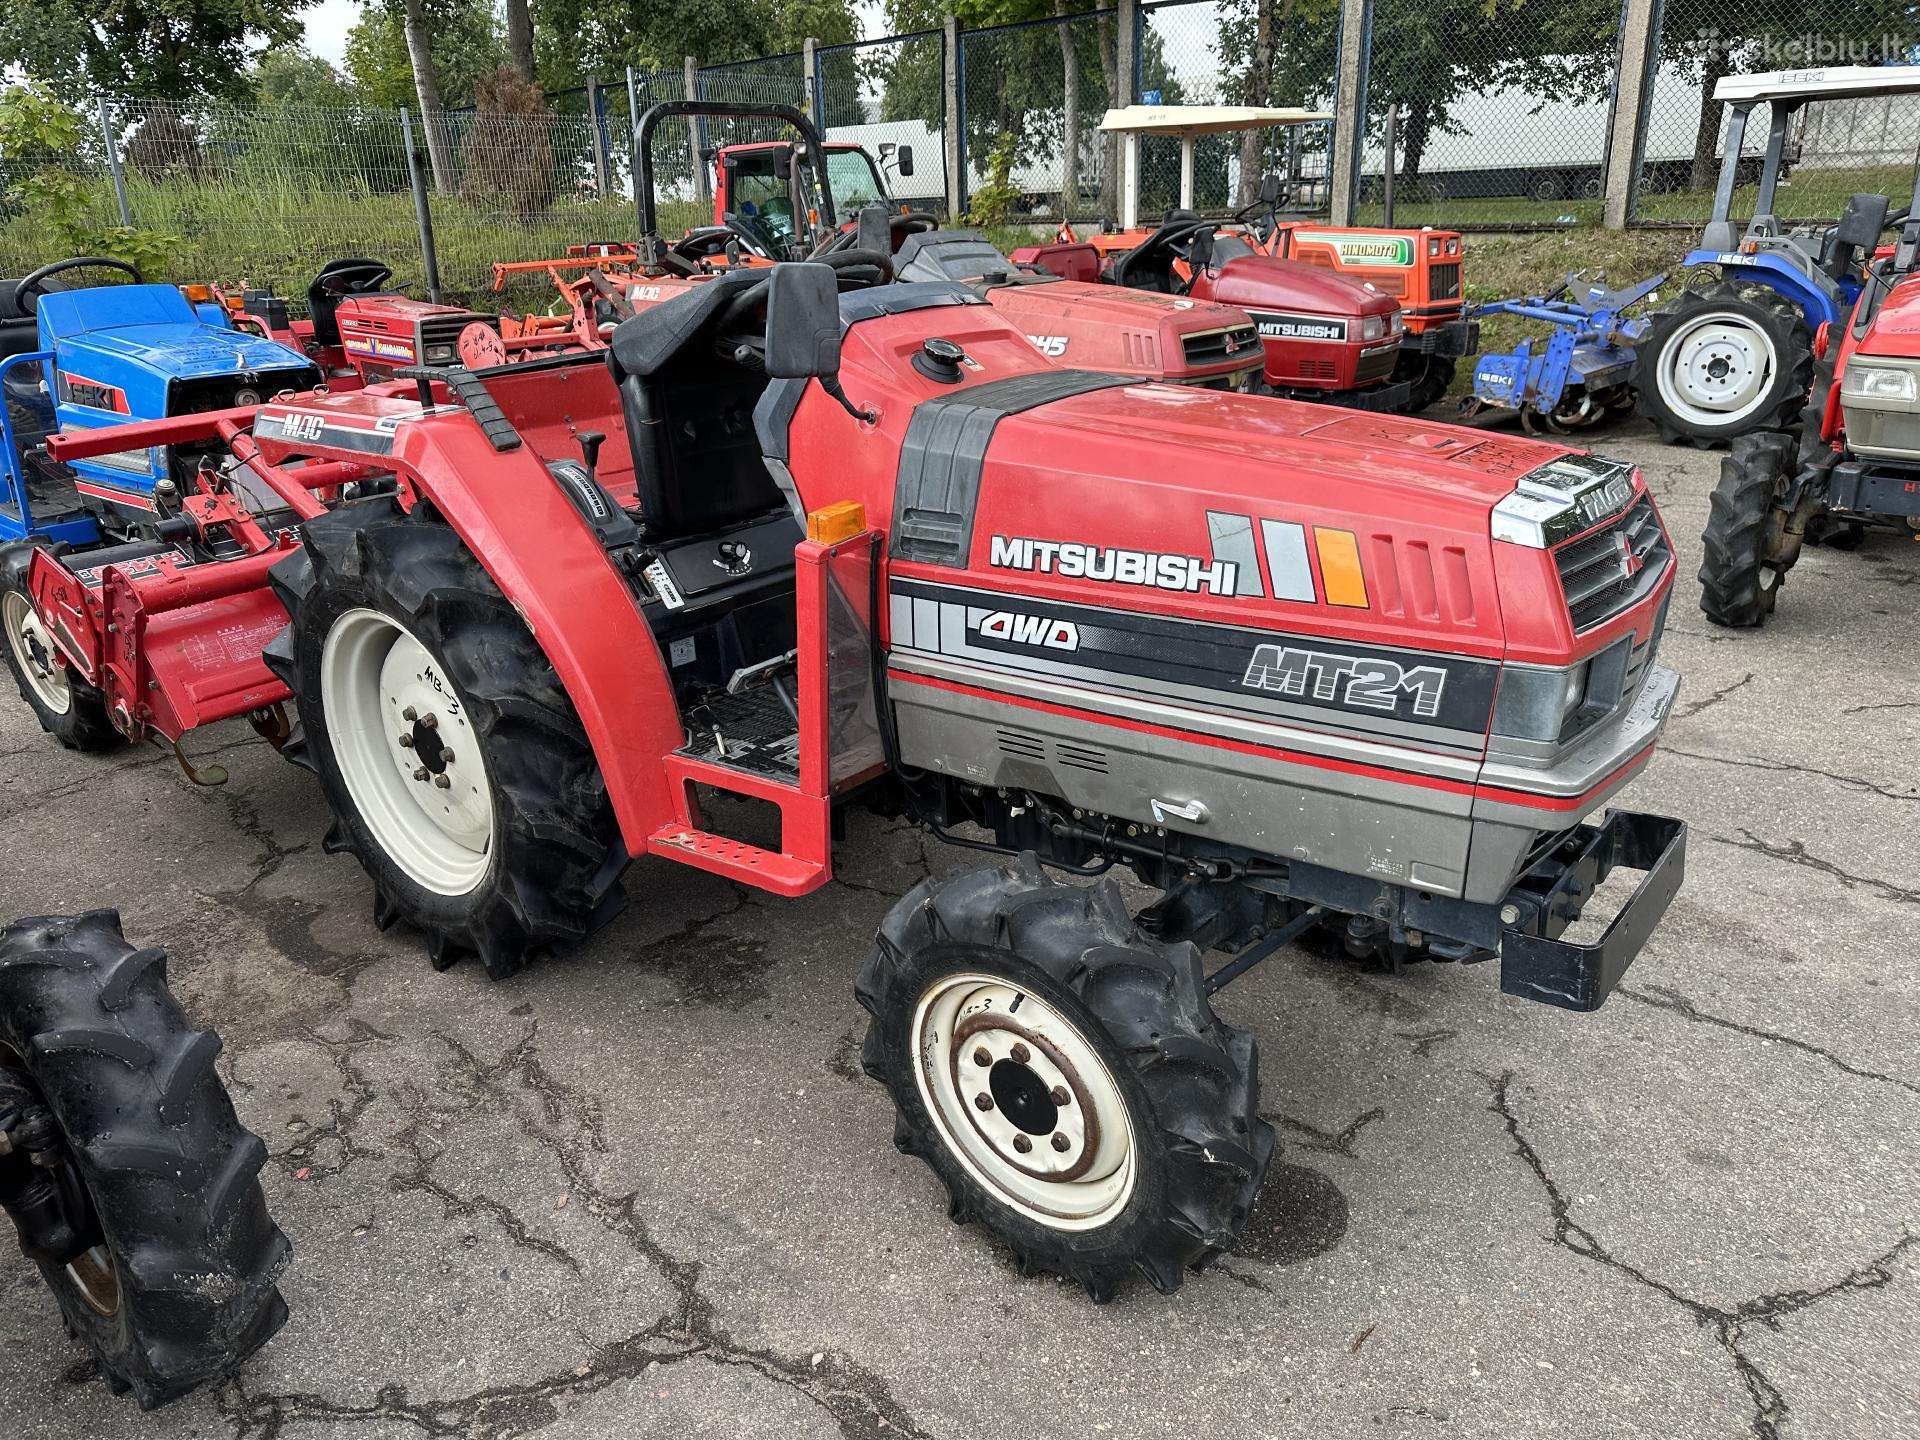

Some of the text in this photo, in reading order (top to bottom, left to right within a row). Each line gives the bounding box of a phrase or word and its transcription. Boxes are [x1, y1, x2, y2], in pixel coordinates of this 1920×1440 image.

[1778, 71, 1825, 83] ISEKI
[1341, 243, 1397, 257] HINOMOTO
[1716, 254, 1758, 266] ISEKI
[631, 285, 660, 300] MAC
[1258, 322, 1340, 339] MITSUBISHI
[1478, 372, 1513, 386] ISEKI
[281, 413, 325, 441] MAC
[990, 535, 1240, 597] MITSUBISHI
[979, 610, 1080, 653] 4WD
[1242, 643, 1448, 717] MT21
[424, 665, 460, 715] MB-3
